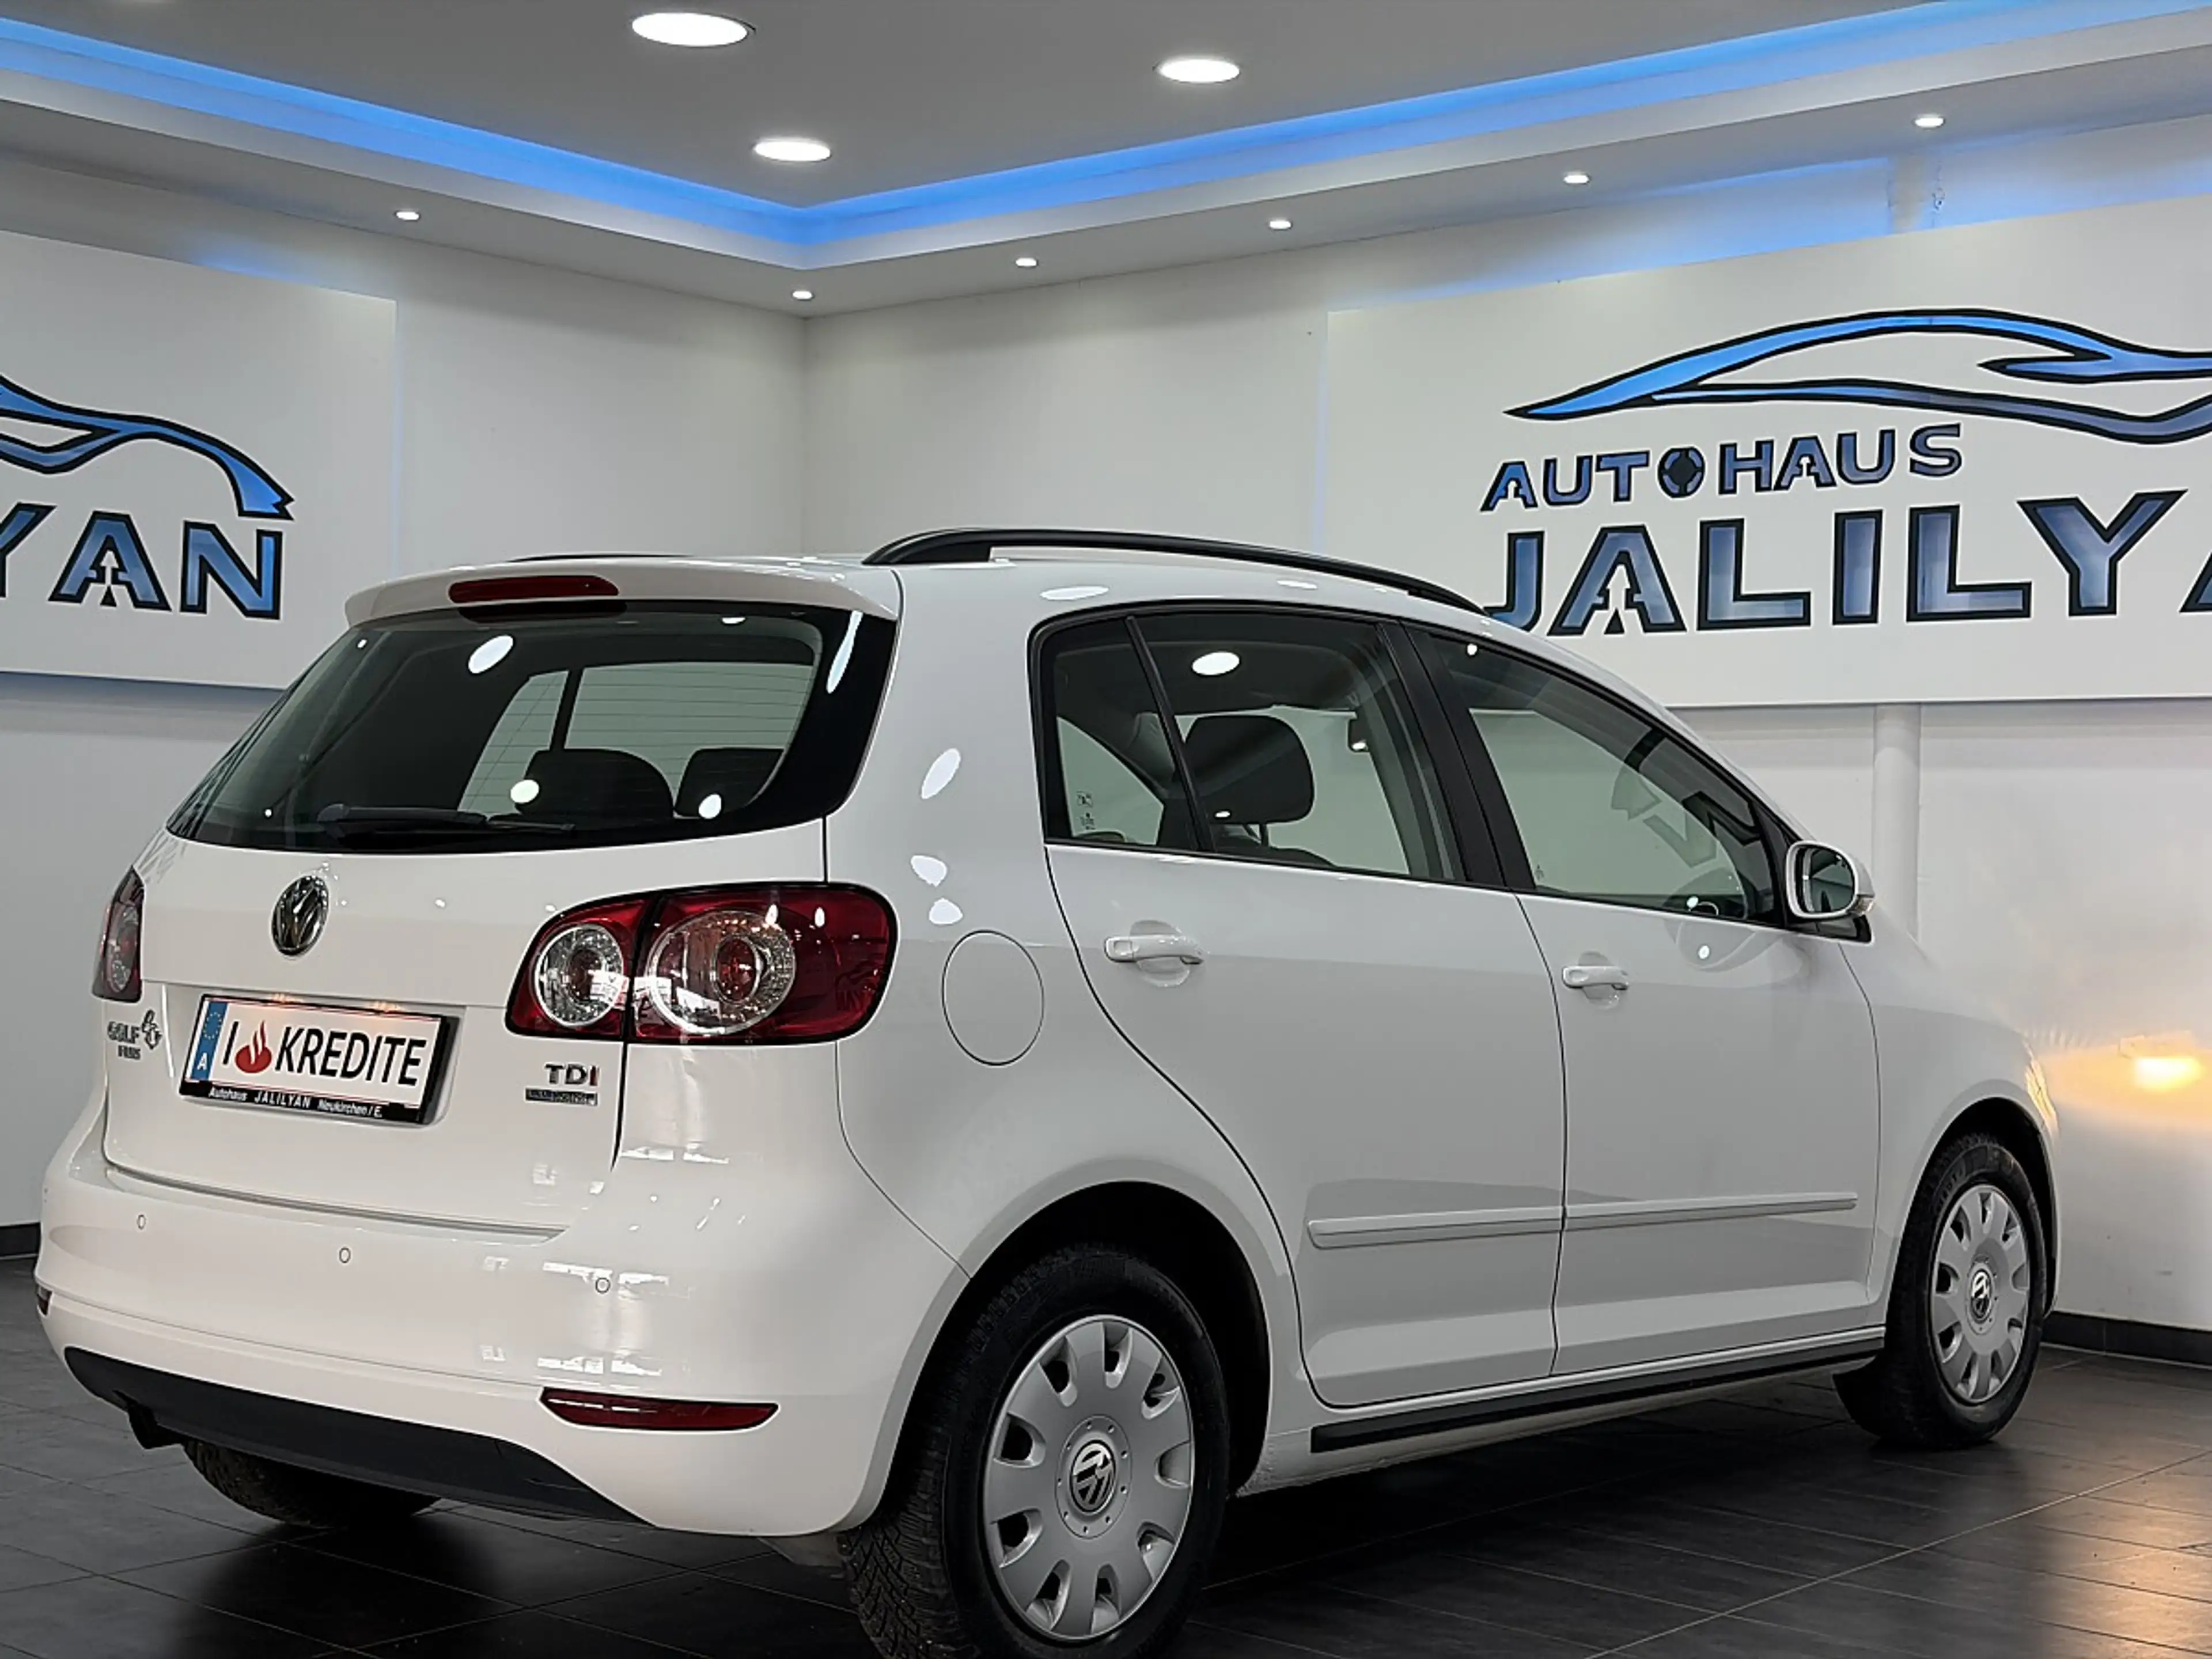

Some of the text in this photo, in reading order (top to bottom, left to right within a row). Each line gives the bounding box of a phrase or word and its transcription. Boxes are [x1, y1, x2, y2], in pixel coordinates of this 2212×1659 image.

[1480, 424, 1961, 511] AUTOHAUS
[1483, 488, 2212, 636] JALILY
[196, 1053, 207, 1070] A
[222, 1021, 427, 1086] I KREDITE
[546, 1064, 598, 1086] TDI
[209, 1086, 247, 1101] Autohaus
[254, 1091, 312, 1109] JALILYAN
